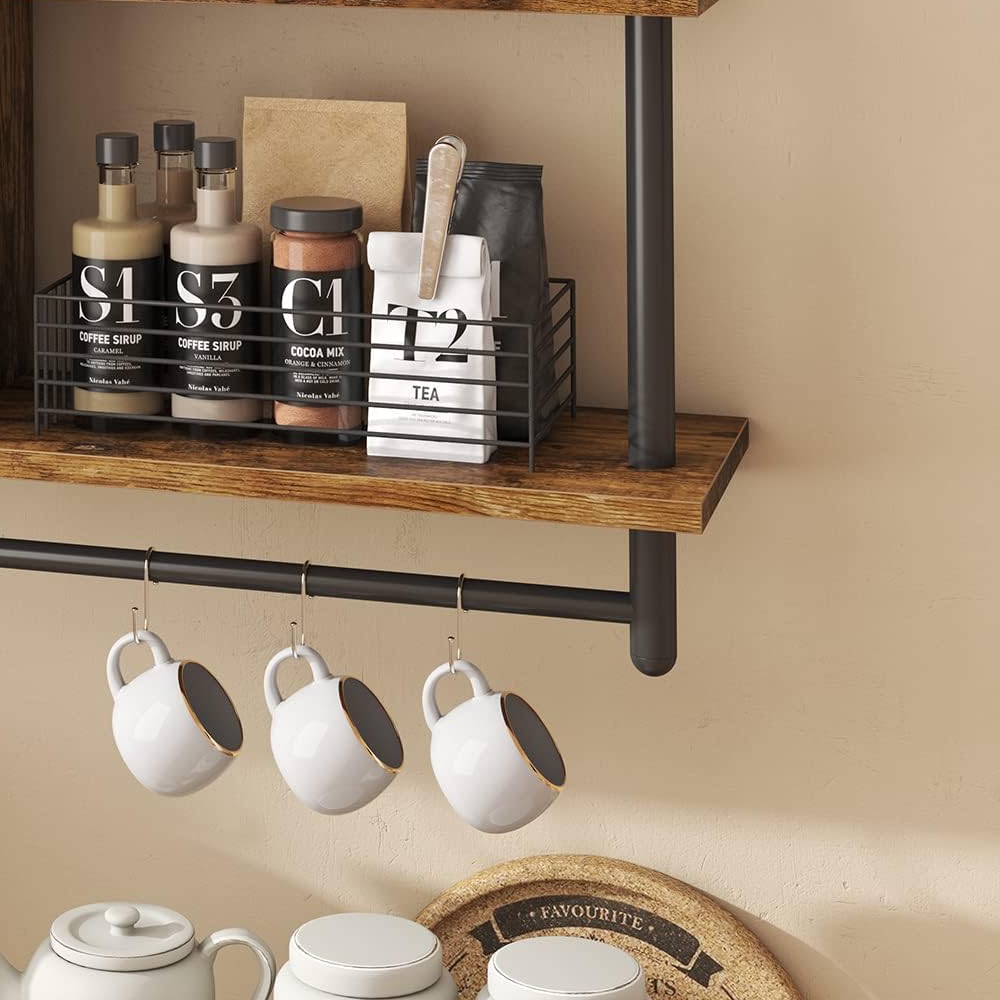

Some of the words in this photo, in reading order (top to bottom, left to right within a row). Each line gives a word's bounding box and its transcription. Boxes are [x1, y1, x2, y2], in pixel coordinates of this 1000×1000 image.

[79, 265, 140, 324] S1
[175, 270, 242, 330] S3
[281, 277, 349, 337] C1
[79, 331, 110, 345] COFFEE
[112, 333, 142, 345] SIRUP
[387, 303, 469, 363] T2
[178, 336, 210, 351] COFFEE
[212, 340, 243, 351] SIRUP
[93, 347, 124, 355] CARAMEL
[194, 353, 223, 361] VANILLA
[290, 345, 324, 358] COCOA
[326, 346, 345, 358] MIX
[284, 358, 310, 368] ORANGE
[316, 359, 351, 368] CINNAMON
[88, 376, 112, 385] Nicolas
[187, 383, 212, 392] Nicolas
[296, 391, 322, 399] Nicolas
[412, 384, 440, 402] TEA
[539, 904, 644, 931] FAVOURITE
